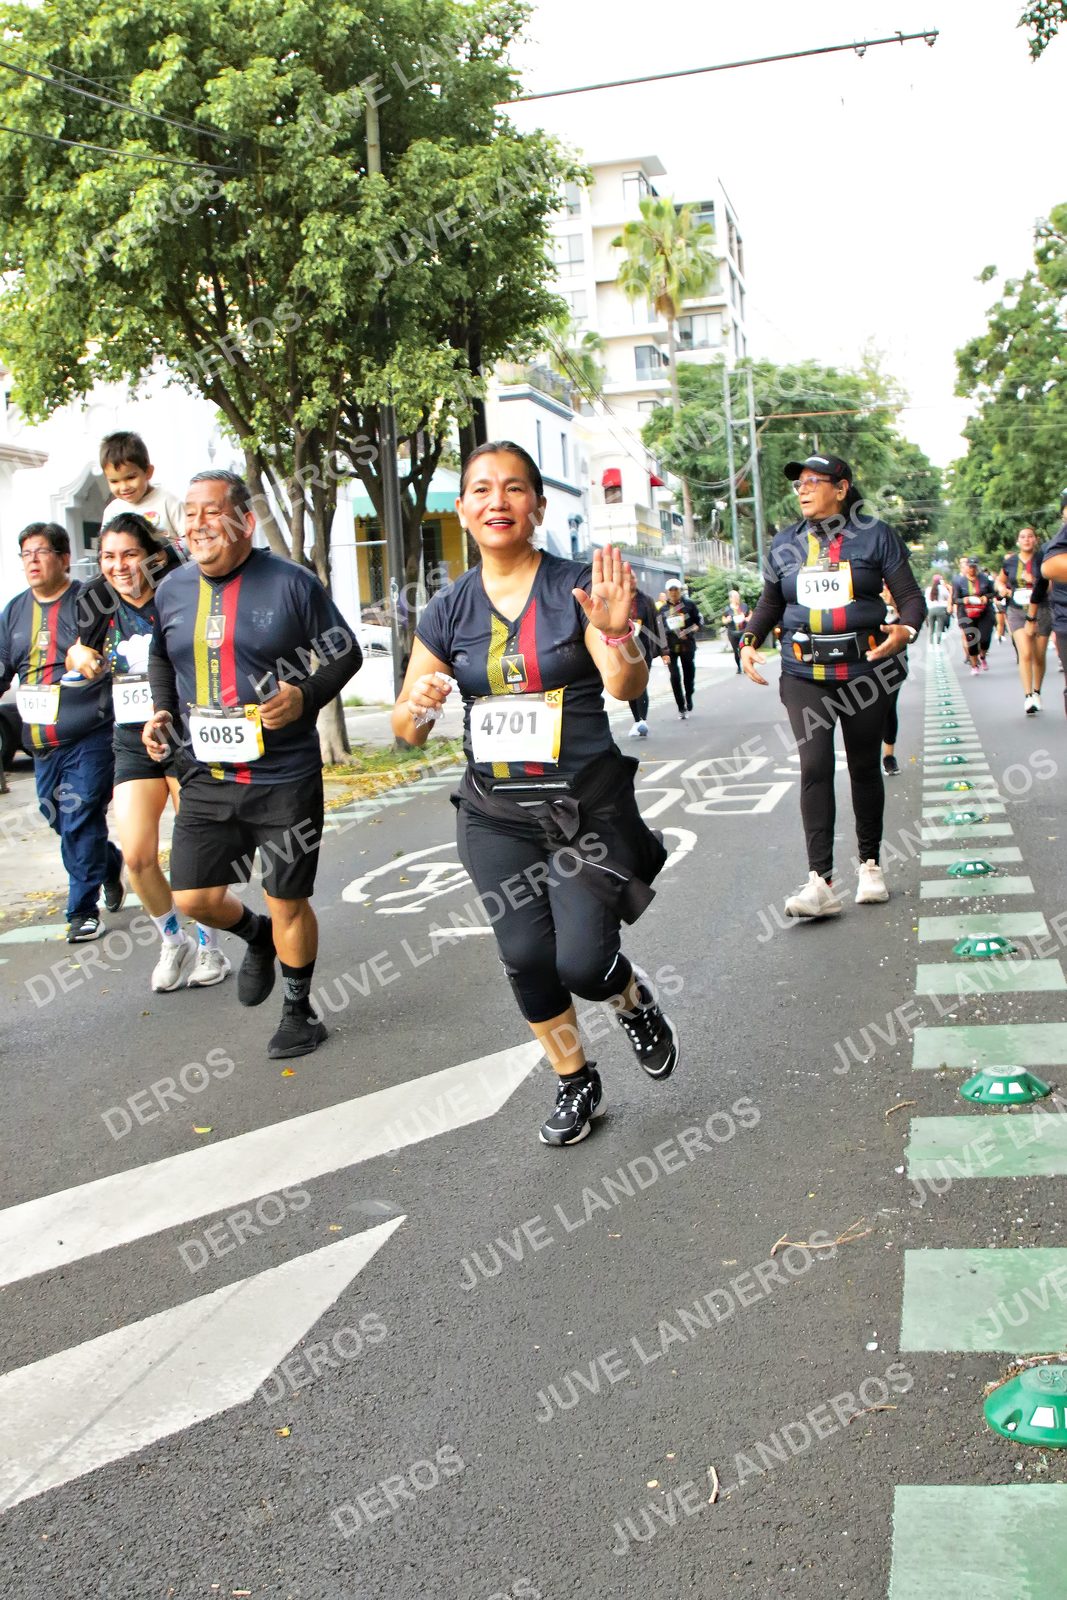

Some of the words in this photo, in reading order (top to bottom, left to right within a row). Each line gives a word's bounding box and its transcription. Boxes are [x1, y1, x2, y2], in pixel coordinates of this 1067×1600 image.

[804, 578, 840, 594] 5196
[122, 688, 150, 705] 565
[480, 710, 537, 736] 4701
[199, 725, 245, 744] 6085
